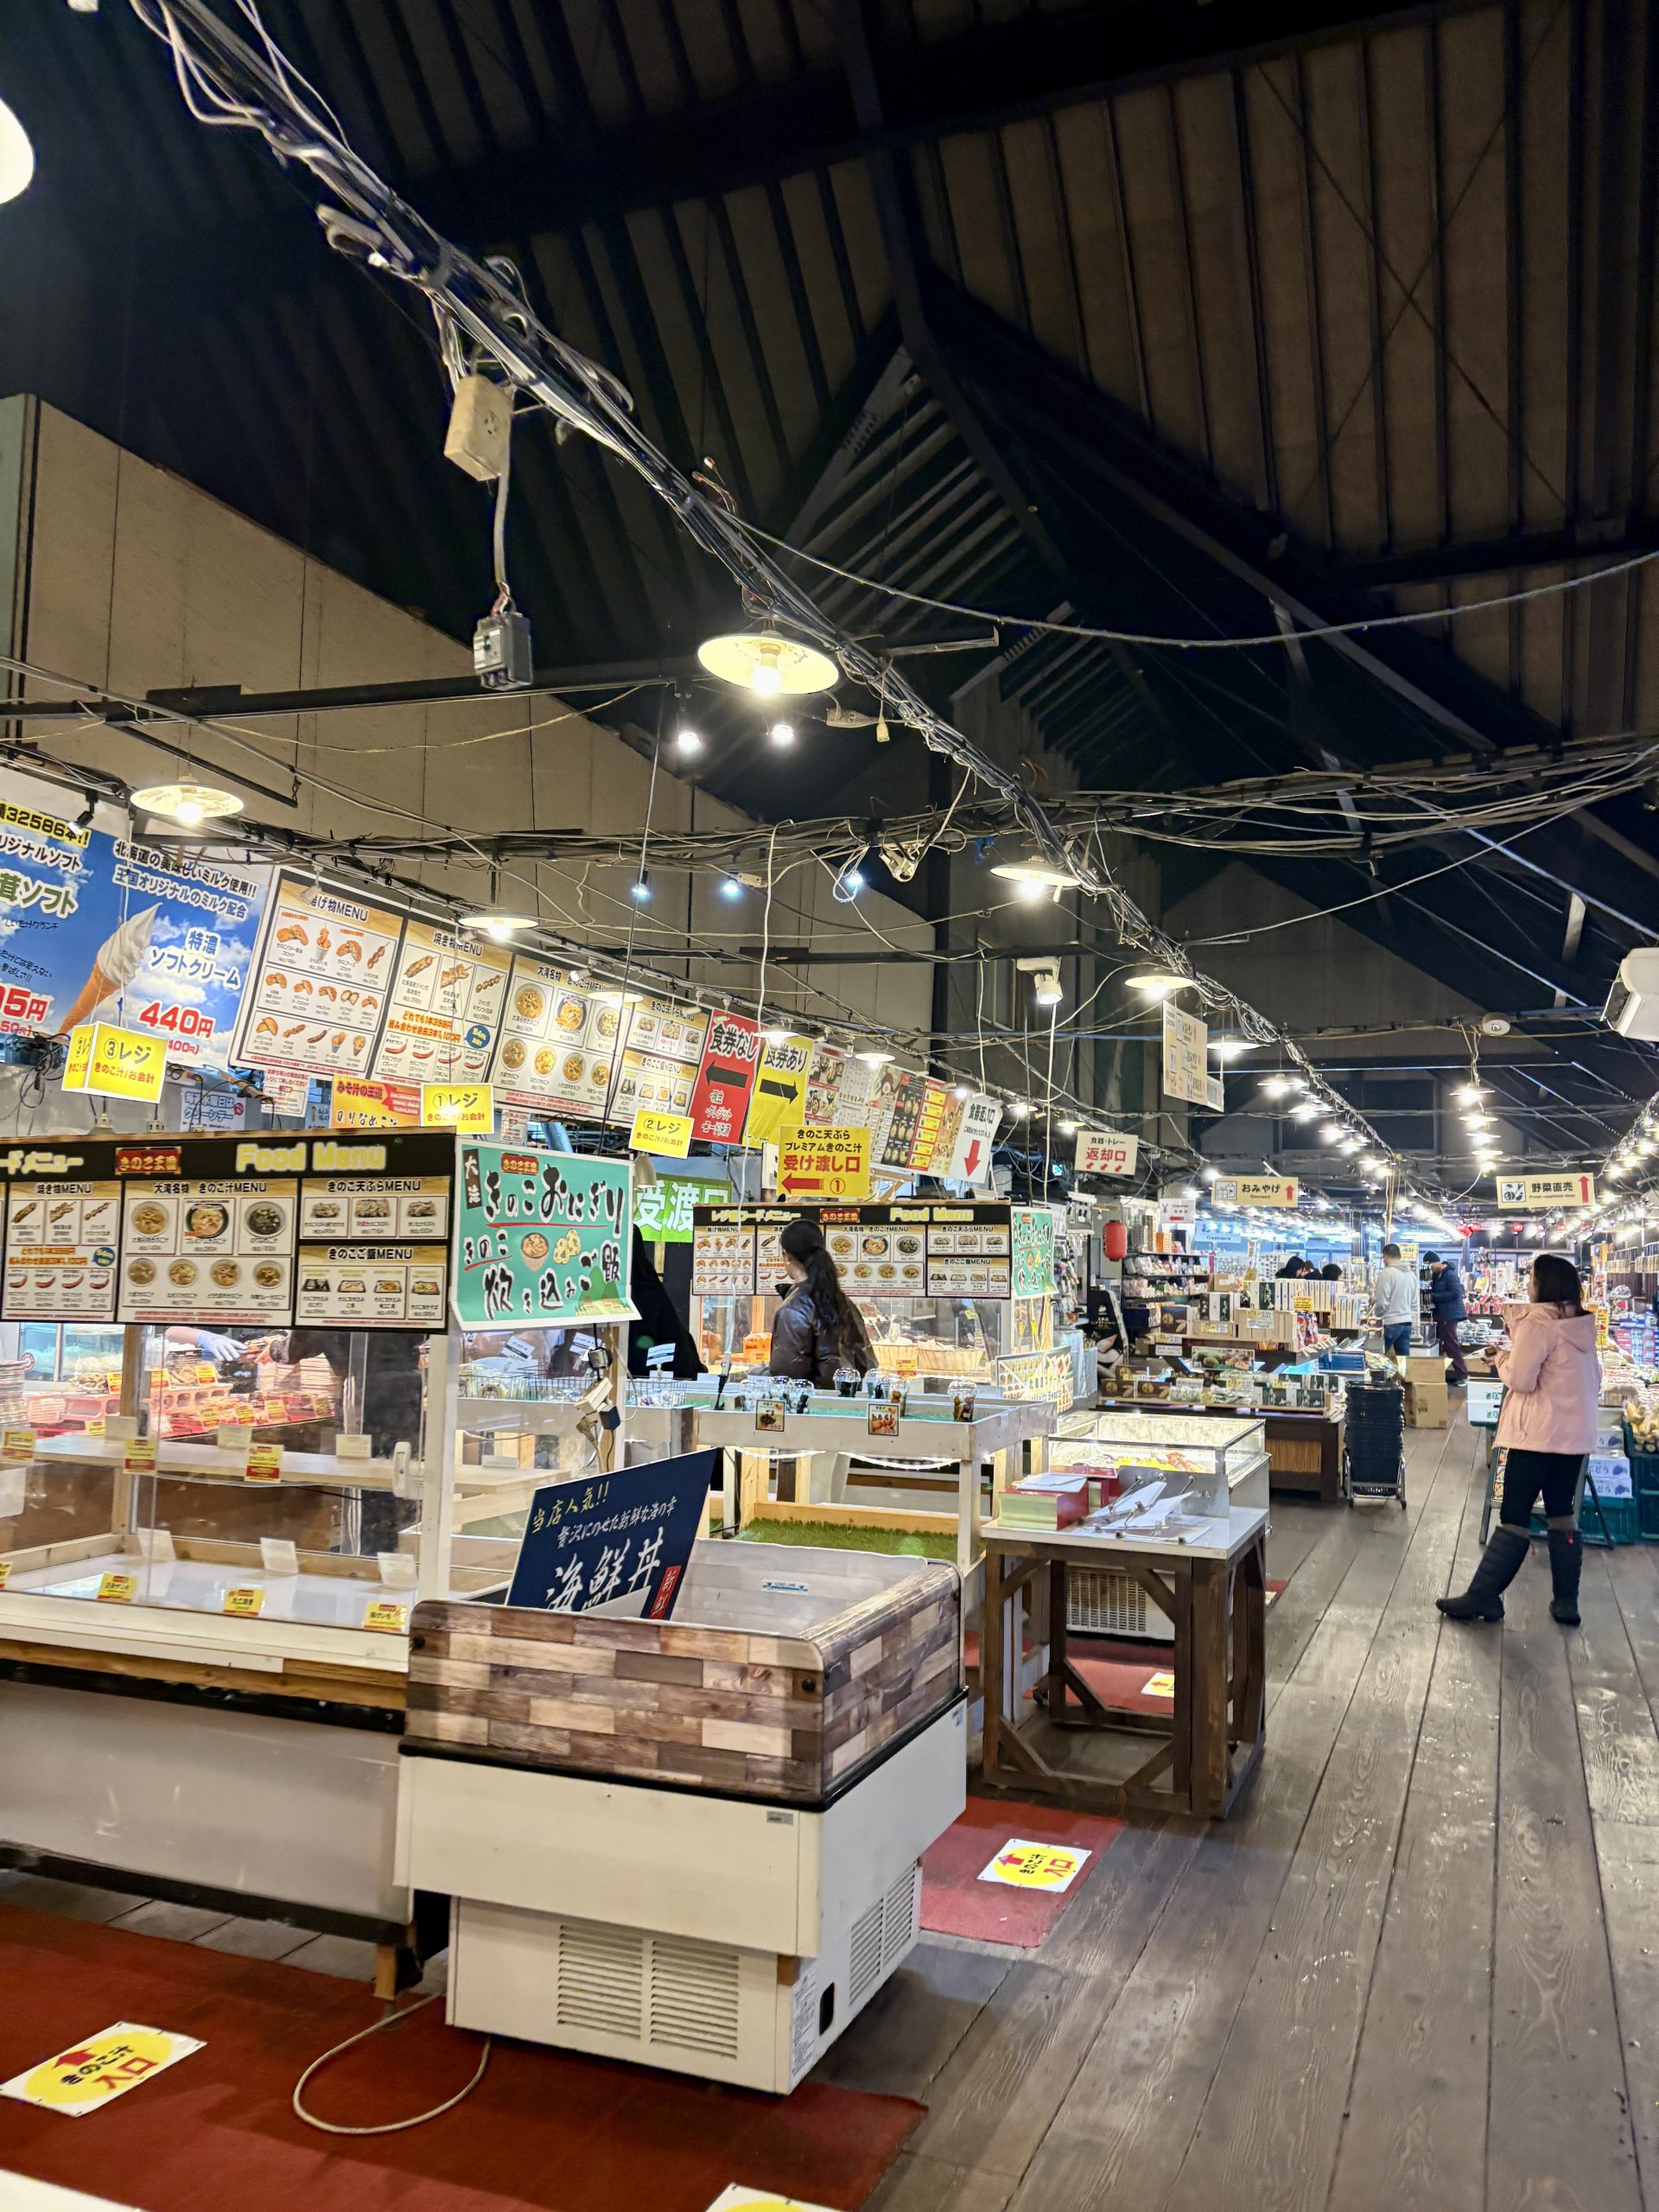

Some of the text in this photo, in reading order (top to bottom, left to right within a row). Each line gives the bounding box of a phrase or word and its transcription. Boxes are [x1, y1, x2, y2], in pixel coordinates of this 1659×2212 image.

[115, 840, 257, 898] 北海道の美味しいミルク使用!!
[114, 867, 247, 919] 王国オリジナルのミルク配合
[188, 930, 220, 955] 特濃
[150, 949, 240, 987] ソフトクリーム
[138, 1001, 214, 1039] 440円
[709, 1024, 758, 1060] 食券なし
[93, 1062, 156, 1085] きのこ汁/お会計
[426, 1113, 486, 1122] きの/お会計
[797, 1128, 851, 1141] きのこ天ぷら
[235, 1141, 387, 1173] Food Menu
[785, 1141, 863, 1154] プレミアムきのこ汁
[1085, 1147, 1127, 1162] 返却口
[783, 1154, 861, 1173] 受け渡し口
[198, 1181, 268, 1194] きのこ汁MENU
[327, 1179, 422, 1193] きのこ天ぷらMENU
[1241, 1183, 1281, 1194] おみやげ
[1531, 1181, 1573, 1193] 野菜直売
[483, 1163, 625, 1238] きのこおにぎり
[890, 1207, 975, 1222] Food Menu
[328, 1248, 414, 1261] きのこご飯MENU
[531, 1480, 610, 1535] 当店人気!!
[544, 1526, 664, 1611] 海鮮丼
[1043, 1859, 1076, 1878] 入口
[92, 2056, 159, 2090] 入口
